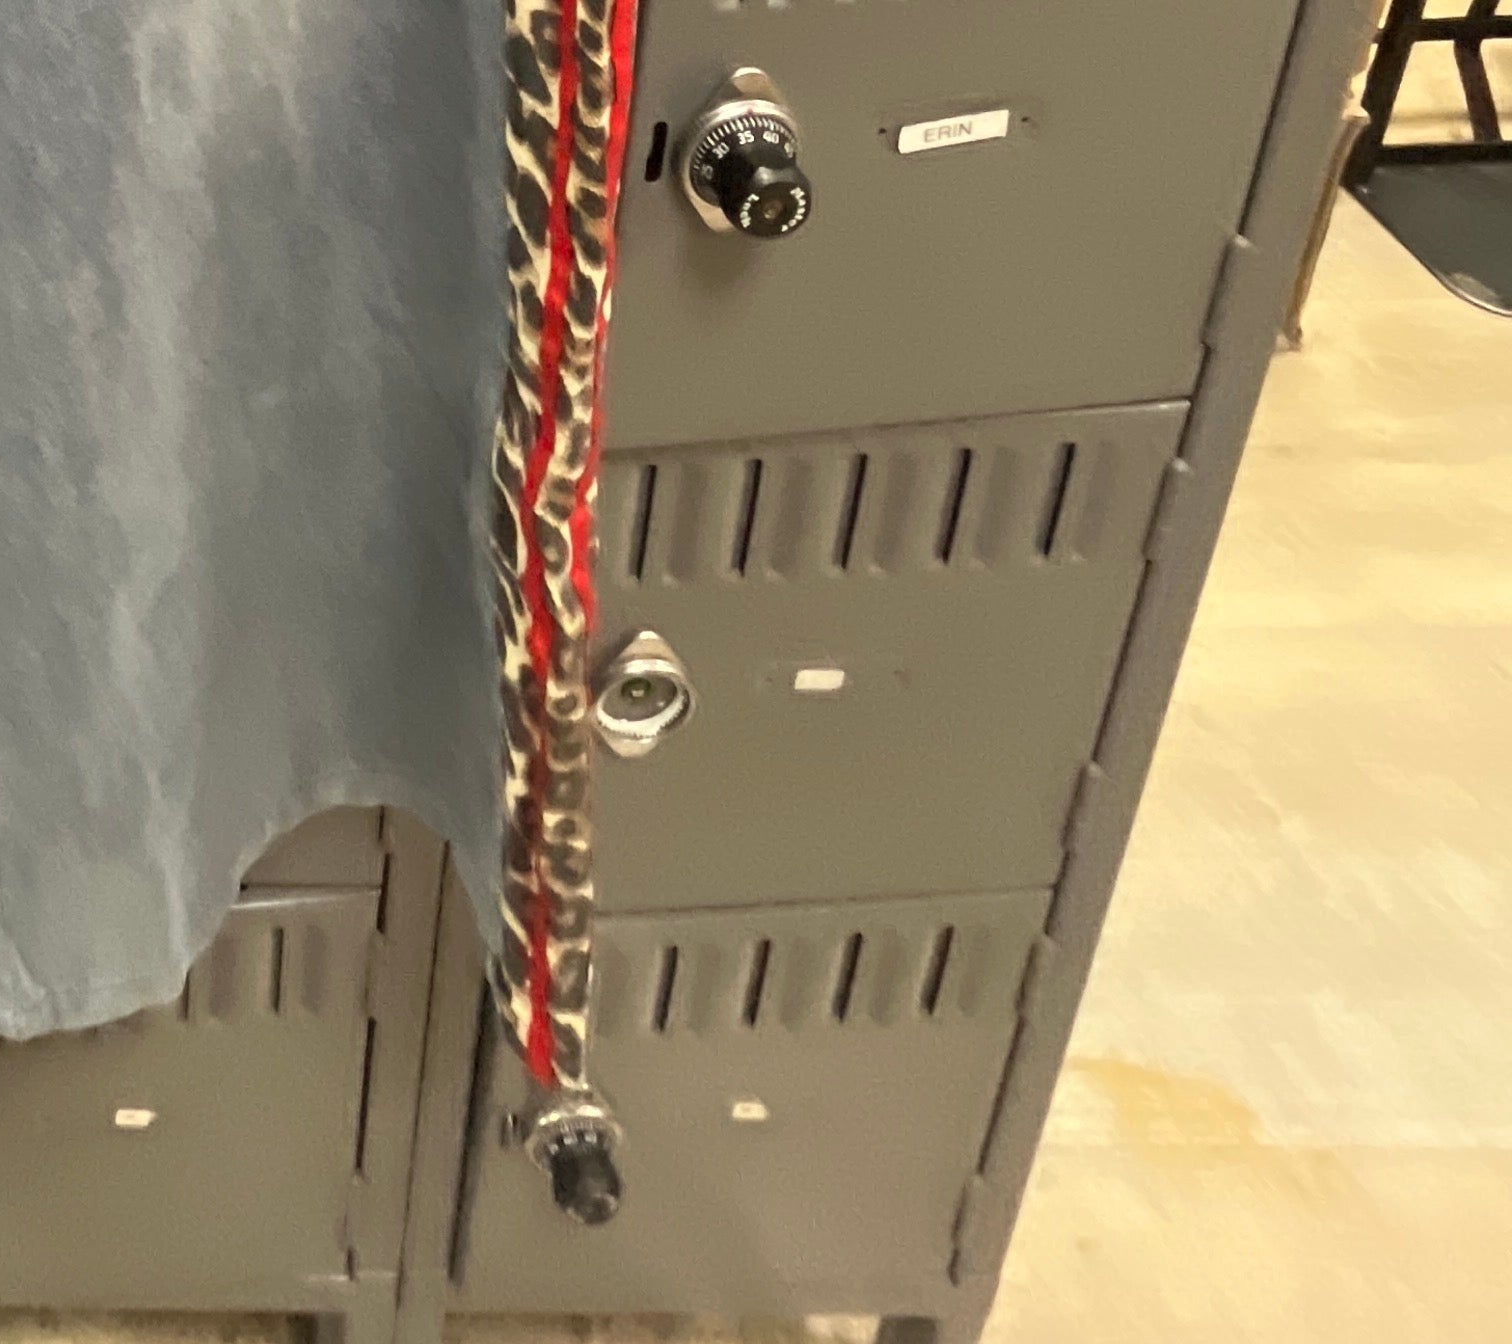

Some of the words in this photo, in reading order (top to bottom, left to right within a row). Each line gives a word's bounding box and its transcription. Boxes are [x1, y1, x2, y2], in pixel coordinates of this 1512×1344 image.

[737, 130, 755, 145] 35
[923, 121, 973, 143] ERIN
[712, 142, 730, 159] 30
